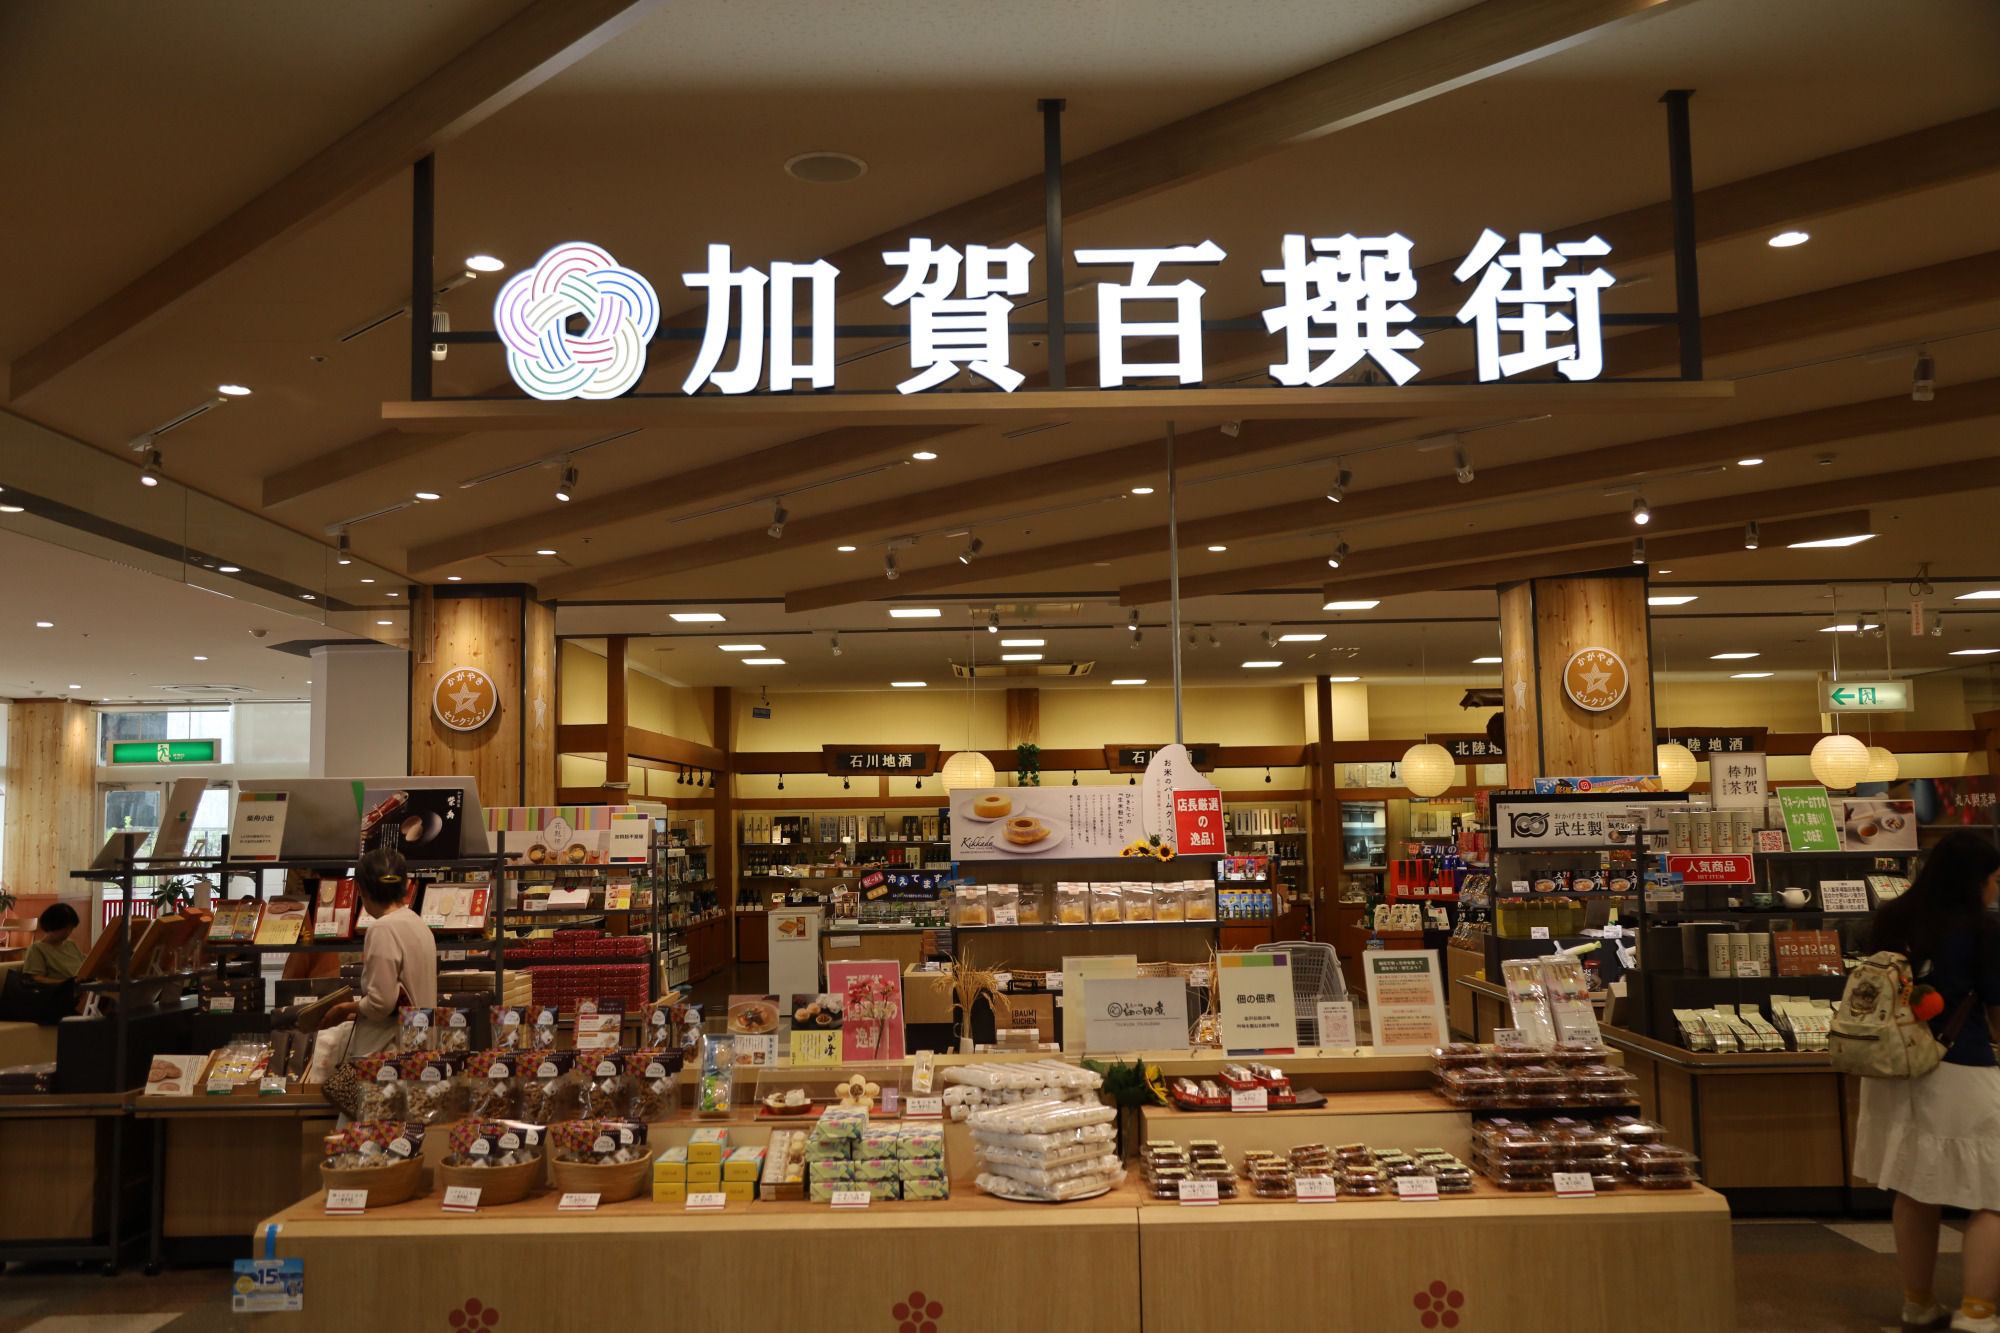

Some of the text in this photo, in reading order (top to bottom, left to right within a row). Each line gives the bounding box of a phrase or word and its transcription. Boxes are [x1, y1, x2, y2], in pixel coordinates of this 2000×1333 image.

[683, 229, 1617, 396] 加賀百撰街
[1576, 689, 1618, 707] セレクション
[444, 708, 486, 726] セレクション
[1455, 740, 1503, 755] 北陸地
[850, 754, 913, 768] 石川地酒
[1728, 765, 1742, 795] 棒茶
[1743, 765, 1758, 795] 加賀
[1177, 797, 1219, 812] 店長厳選
[1955, 793, 1997, 807] 丸八製茶場
[1198, 816, 1208, 828] の
[1554, 821, 1603, 837] 武生製
[960, 835, 995, 850] Kikkado
[1190, 832, 1215, 846] 逸品!
[1686, 860, 1736, 873] 人気商品
[1237, 994, 1275, 1004] 佃の佃煮
[258, 1268, 279, 1284] 15
